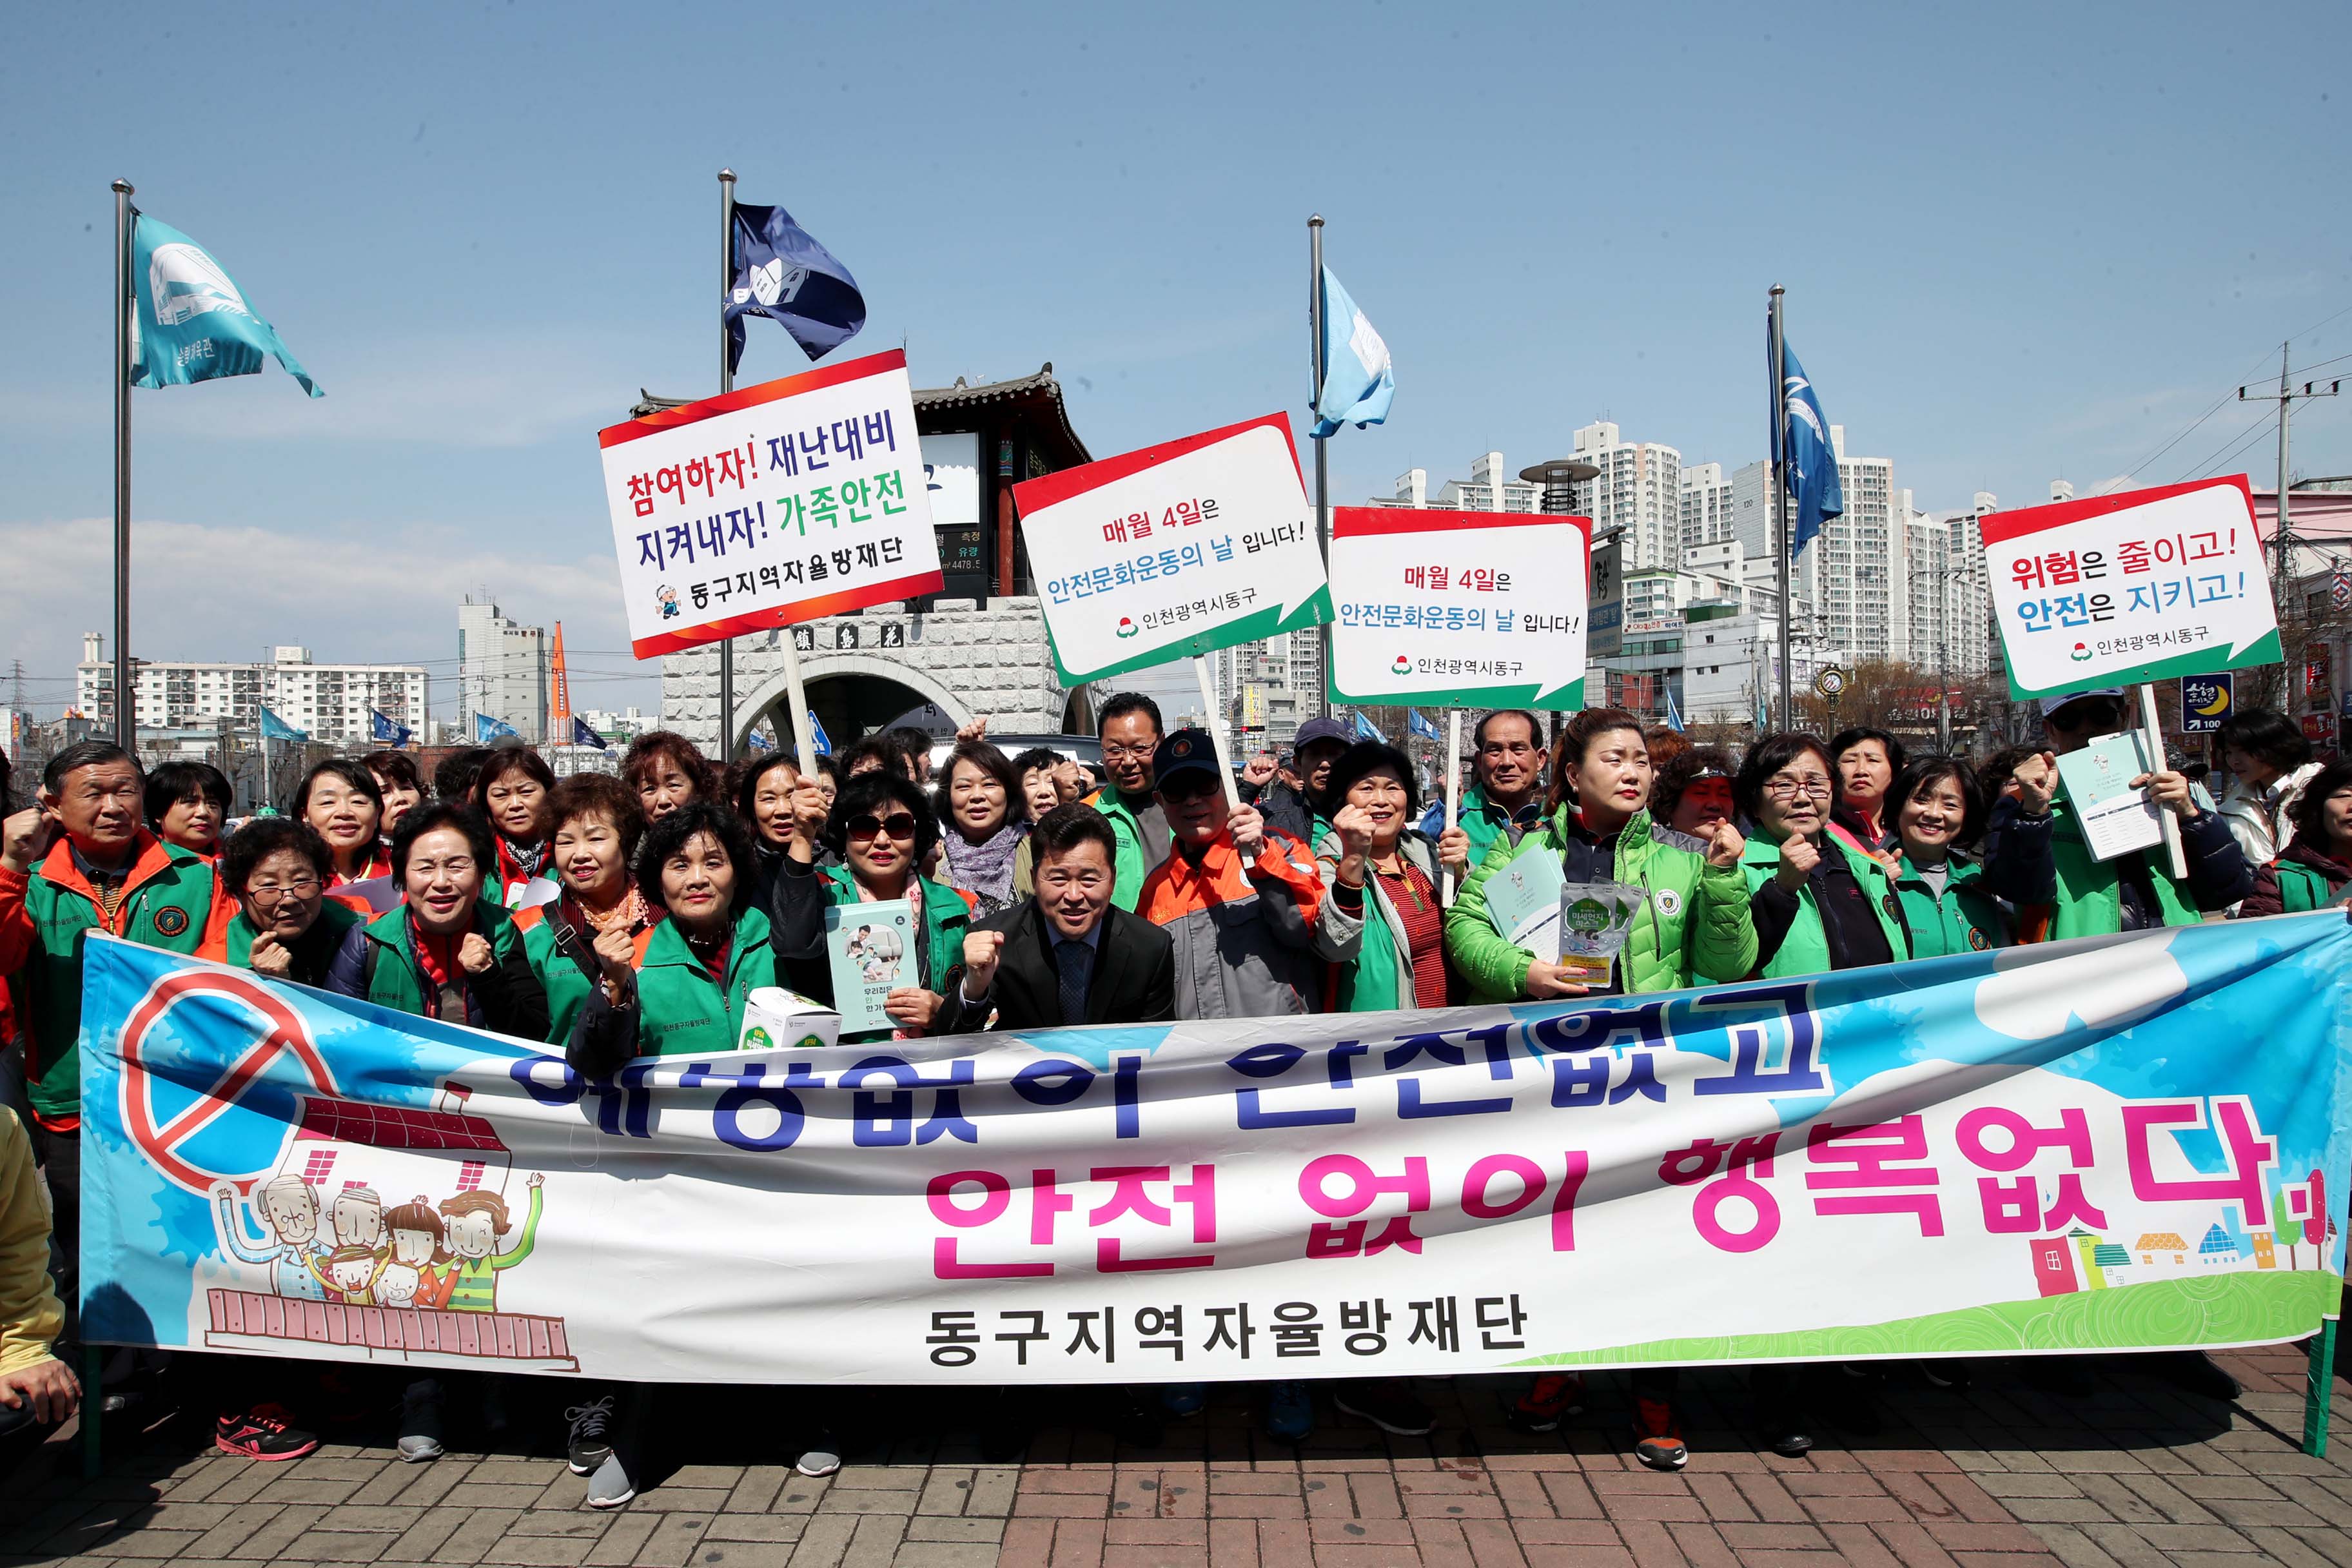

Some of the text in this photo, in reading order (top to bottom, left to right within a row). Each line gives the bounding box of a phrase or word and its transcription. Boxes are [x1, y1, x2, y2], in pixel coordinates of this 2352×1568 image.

[627, 409, 896, 517] 참여하자! 재난대비
[636, 469, 907, 572] 지켜내자! 가족안전
[1102, 498, 1220, 544] 매월 4일은
[1743, 499, 1753, 508] 120
[690, 537, 904, 609] 동구지역자율방재단
[1047, 521, 1306, 605] 안전문화운동의 날 입니다!
[1404, 566, 1512, 592] 매월 4일은
[2012, 528, 2236, 590] 위험은 줄이고!
[1142, 587, 1258, 630] 인천광역시동구
[1340, 603, 1485, 632] 안전문화운동의
[1494, 609, 1515, 632] 날
[1523, 614, 1580, 634] 입니다!
[2017, 571, 2245, 633] 안전은 지키고!
[1417, 658, 1524, 677] 인천광역시동구
[2097, 625, 2210, 656] 인천광역시동구
[1572, 912, 1603, 921] 미세먼지
[864, 986, 893, 995] 우리집은
[1225, 983, 1823, 1131] 안전없고
[926, 1163, 1216, 1280] 안전
[1297, 1150, 1589, 1260] 없이
[925, 1293, 1528, 1367] 동구지역자율방재단
